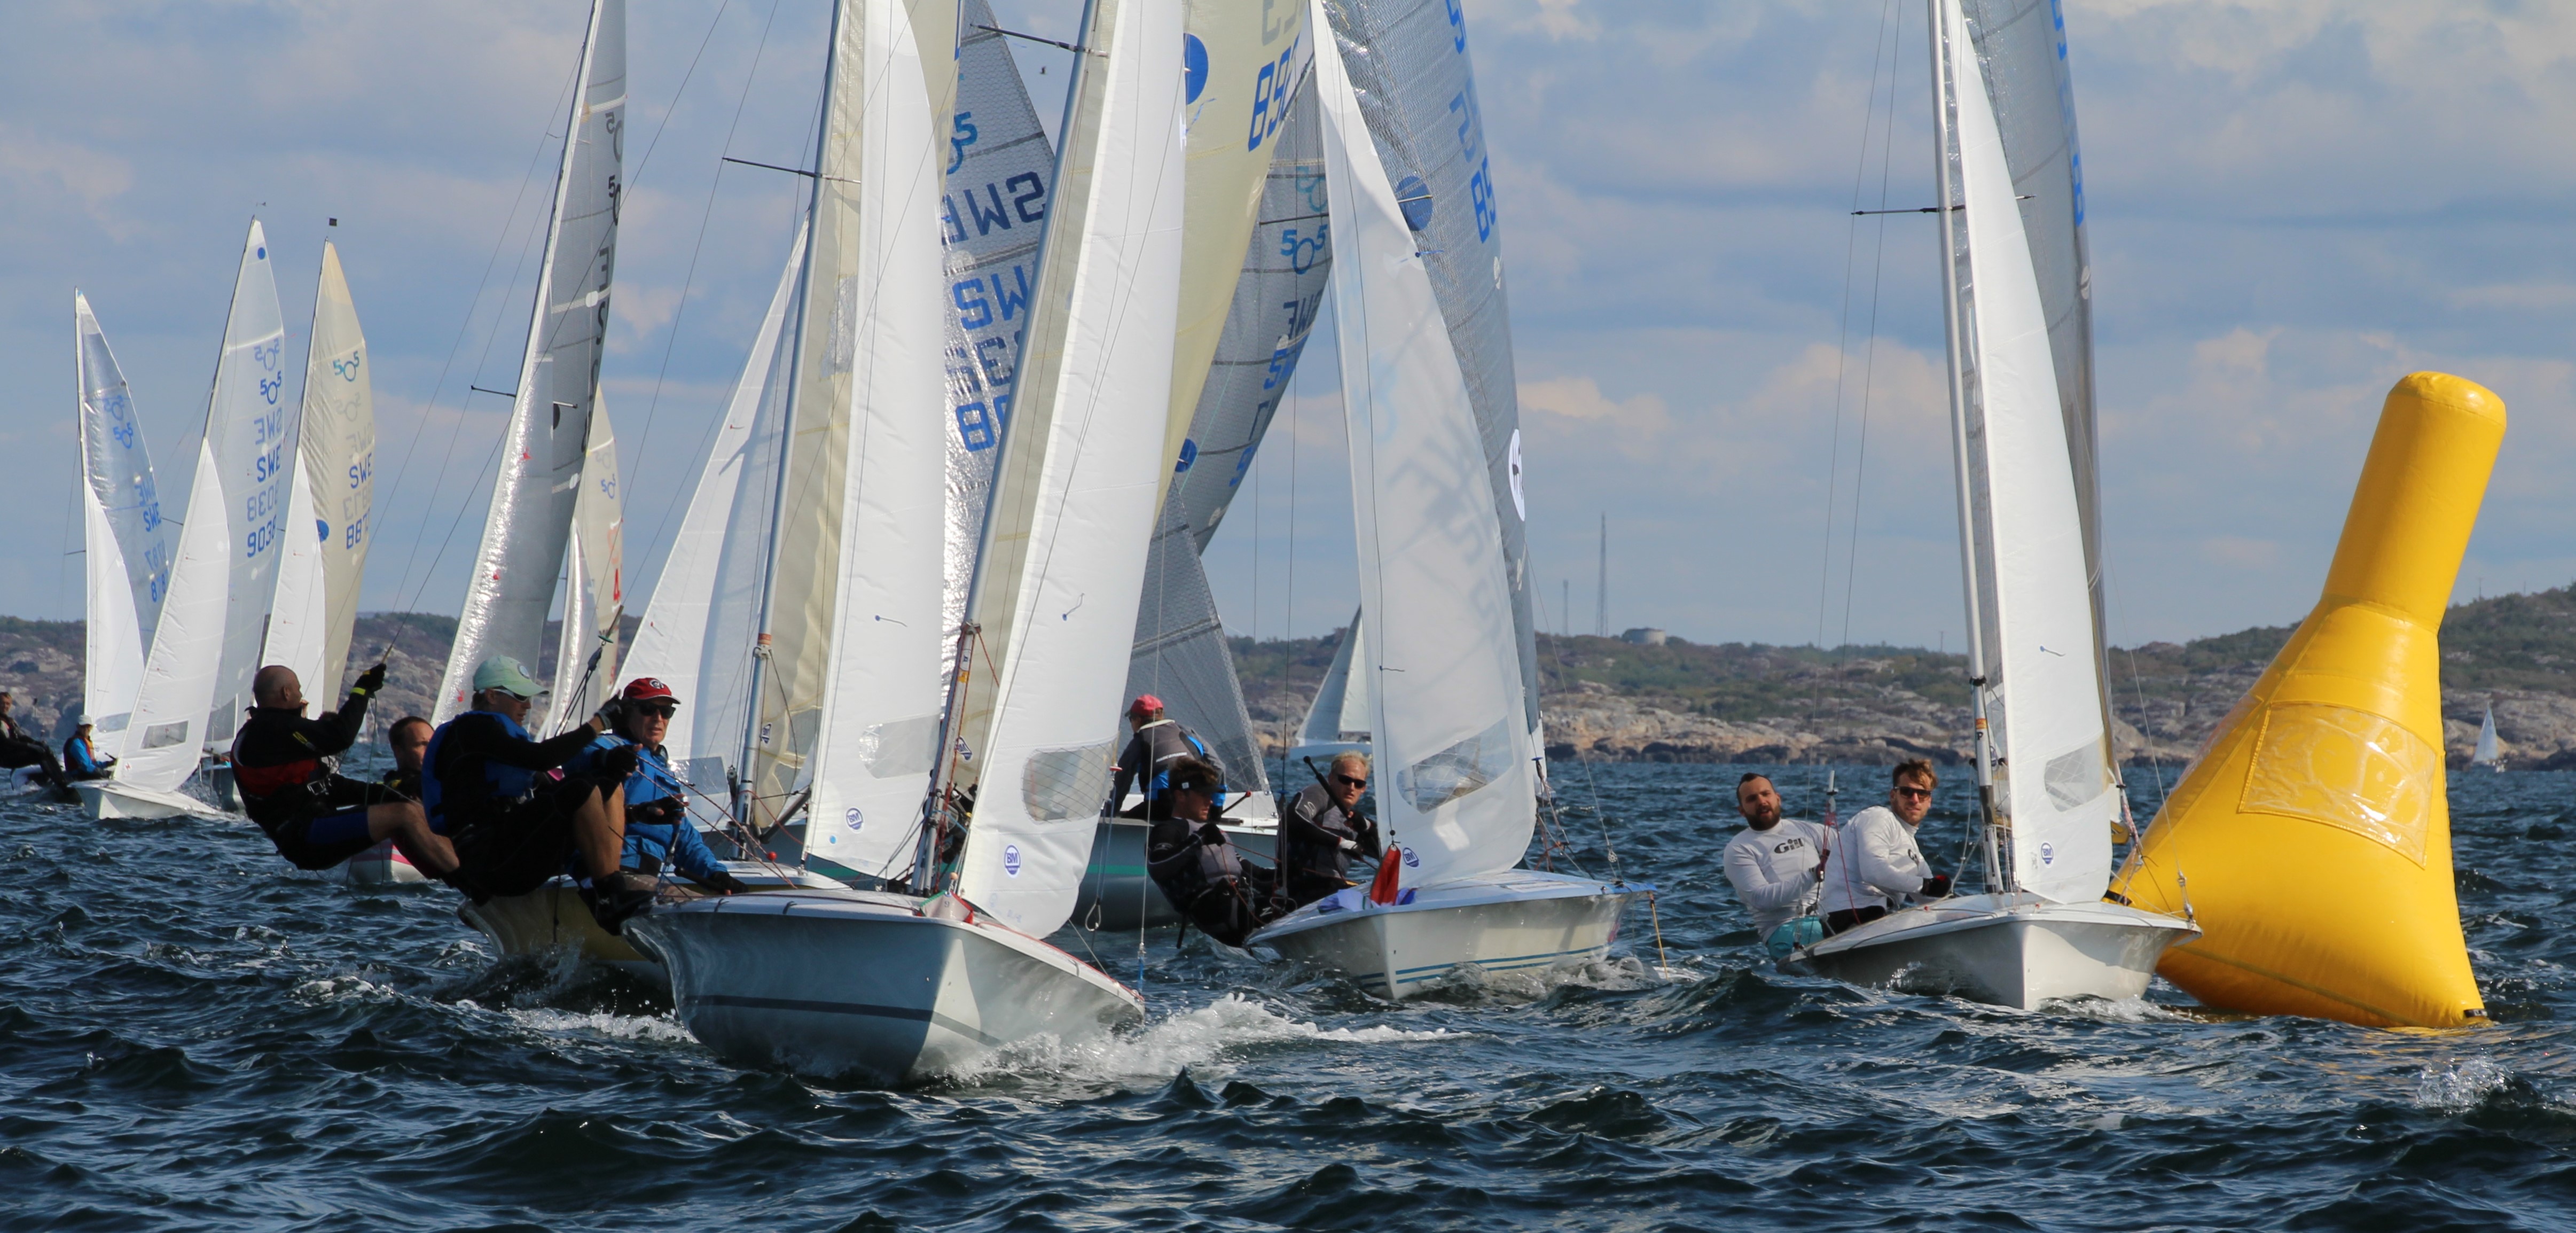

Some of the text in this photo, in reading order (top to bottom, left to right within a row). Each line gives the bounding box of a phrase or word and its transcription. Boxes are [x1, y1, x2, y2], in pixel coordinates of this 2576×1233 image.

[1281, 224, 1328, 275] 505
[952, 264, 1031, 331] SW
[333, 350, 360, 383] 505
[260, 370, 282, 405] 505
[257, 444, 281, 482] SWE
[349, 452, 372, 489] SWE
[347, 506, 371, 550] 887
[847, 813, 860, 823] BM
[1007, 852, 1018, 863] BM
[1774, 838, 1804, 854] Gill
